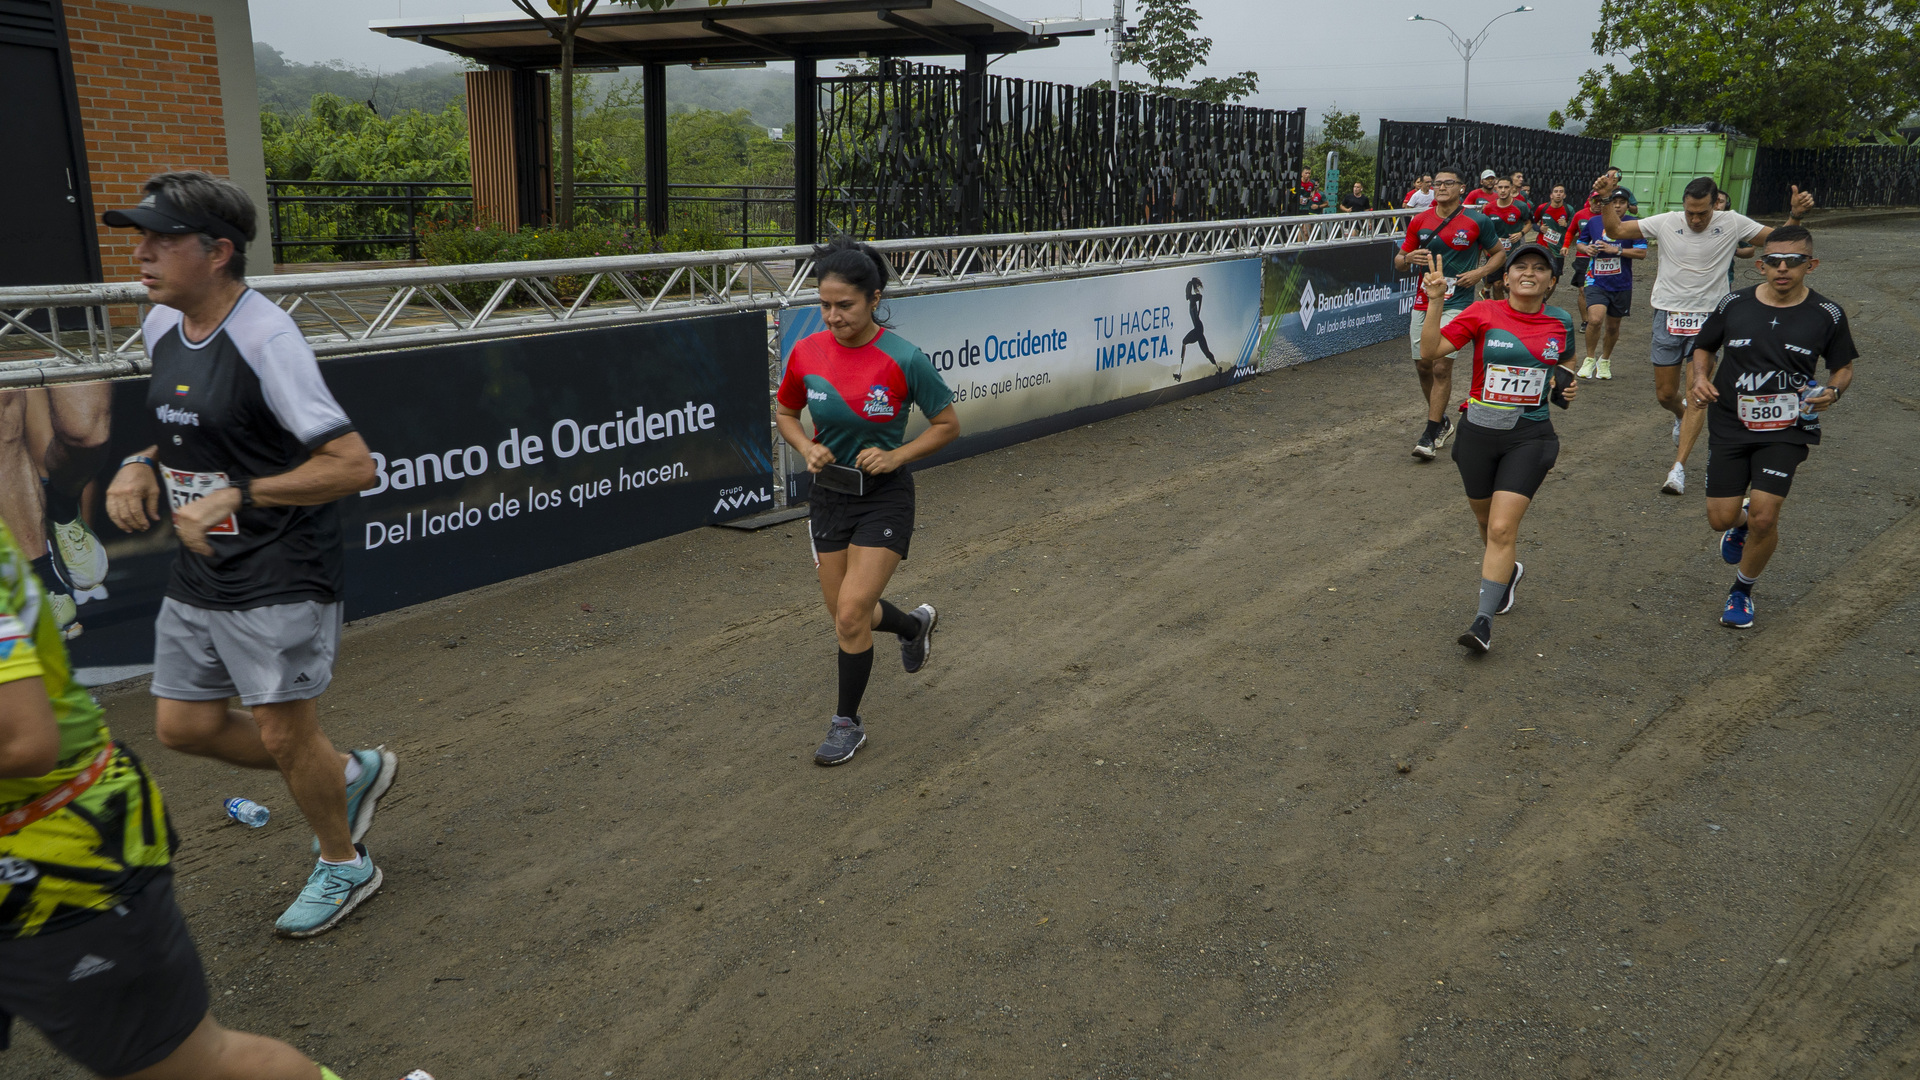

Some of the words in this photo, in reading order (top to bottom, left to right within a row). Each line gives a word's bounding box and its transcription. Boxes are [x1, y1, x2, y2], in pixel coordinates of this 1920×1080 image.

[1317, 293, 1342, 312] Banco
[1343, 288, 1353, 307] de
[1354, 285, 1391, 305] Occidente
[1094, 314, 1114, 341] TU
[1120, 306, 1174, 336] HACER,
[1316, 320, 1327, 336] Del
[1339, 316, 1347, 329] de
[1347, 315, 1355, 328] los
[1355, 316, 1365, 329] que
[1674, 318, 1699, 328] 1691
[958, 339, 981, 368] de
[984, 328, 1068, 363] Occidente
[1096, 334, 1173, 372] IMPACTA.
[1233, 365, 1256, 379] AVAL
[1501, 377, 1530, 393] 717
[952, 384, 967, 404] de
[970, 381, 987, 400] los
[990, 379, 1012, 399] que
[1015, 372, 1051, 391] hacen.
[1751, 405, 1782, 420] 580
[359, 445, 488, 498] Banco
[497, 428, 544, 470] de
[551, 401, 716, 459] Occidente
[713, 487, 771, 515] AVAL
[719, 485, 743, 497] Grupo
[364, 513, 412, 551] Del
[422, 502, 481, 538] lado
[488, 492, 520, 522] de
[528, 486, 562, 513] los
[569, 475, 612, 508] que
[619, 460, 690, 492] hacen.
